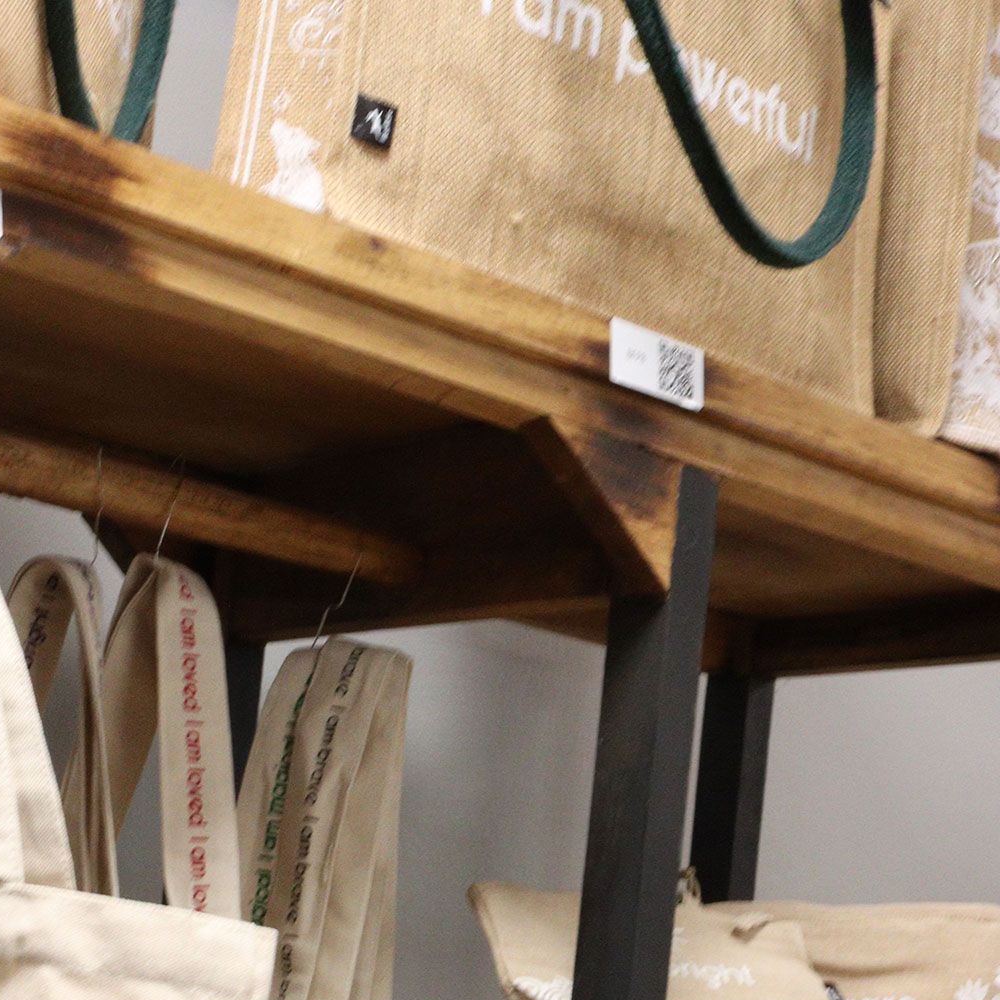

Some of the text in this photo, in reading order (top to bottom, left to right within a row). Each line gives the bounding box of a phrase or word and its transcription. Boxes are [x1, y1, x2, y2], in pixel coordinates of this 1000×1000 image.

[511, 0, 820, 166] am pwerful
[185, 730, 202, 764] am
[186, 767, 207, 828] loved
[190, 846, 207, 880] am
[192, 884, 211, 913] lov
